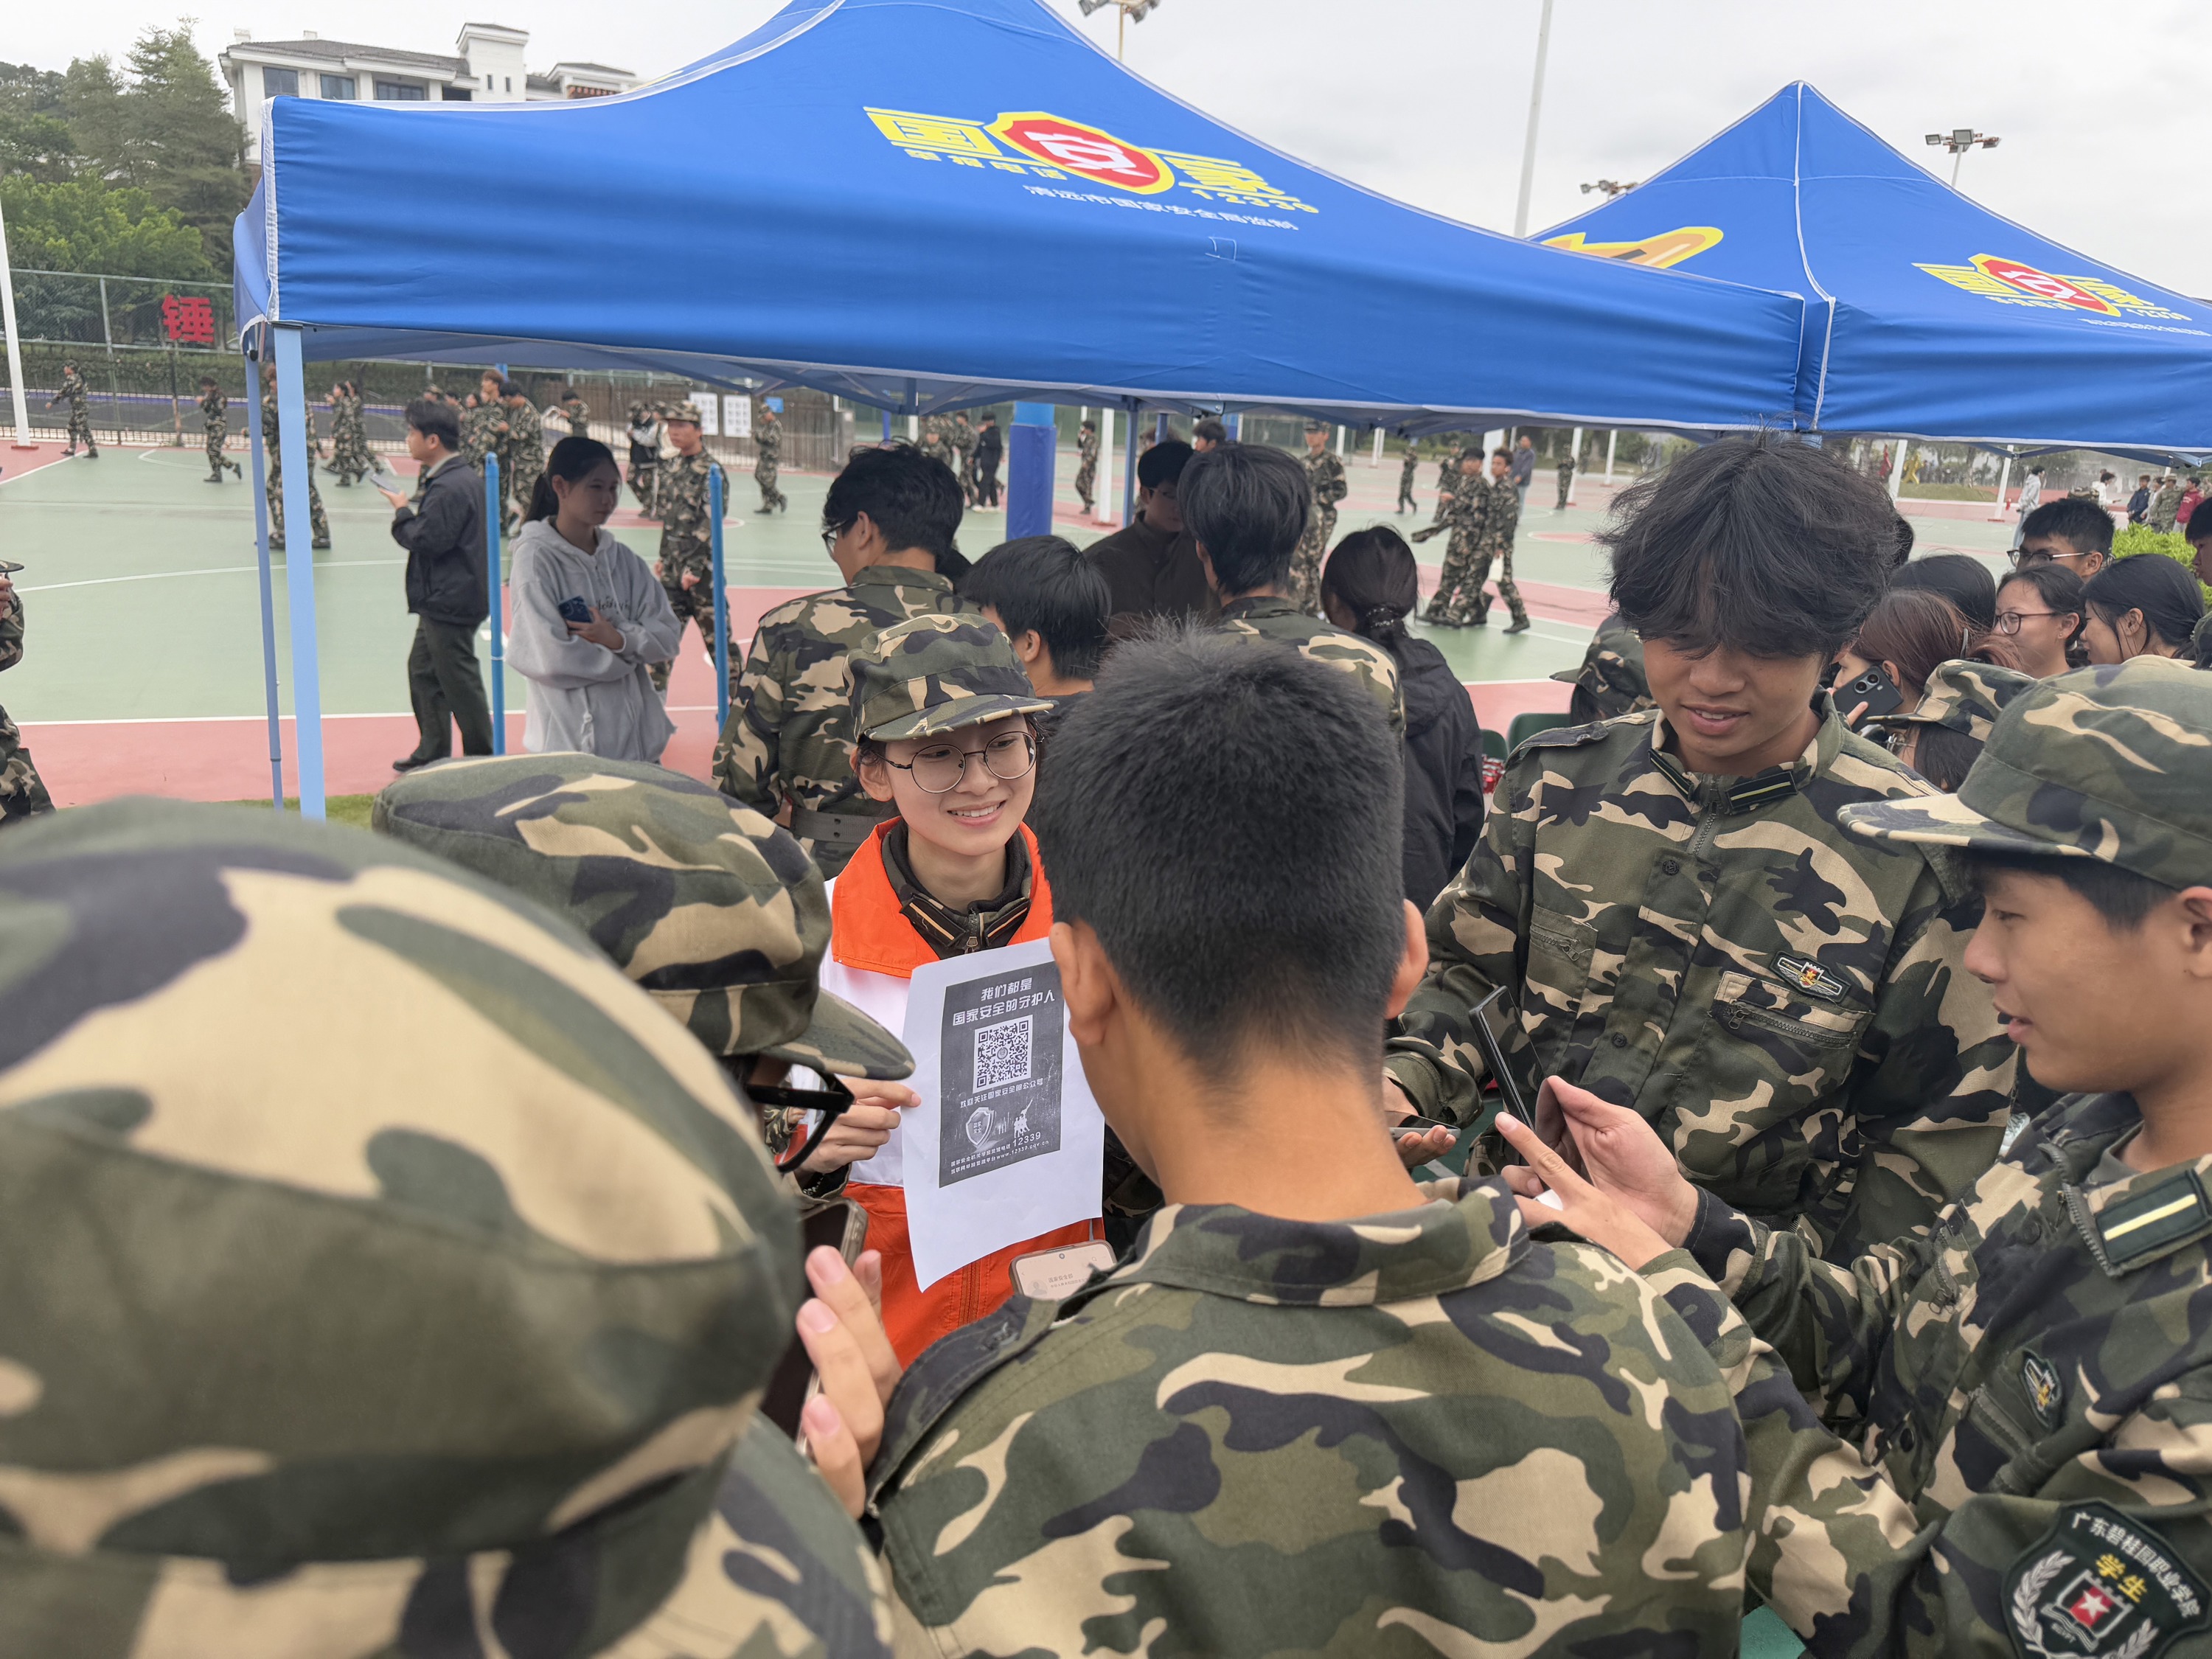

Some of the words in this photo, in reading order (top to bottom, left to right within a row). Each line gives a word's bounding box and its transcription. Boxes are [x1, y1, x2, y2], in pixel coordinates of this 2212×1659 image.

[1192, 189, 1319, 214] 12339
[162, 294, 215, 343] 锤
[953, 989, 1055, 1026] 国家安全的守护人
[981, 977, 1032, 1001] 我们都是
[1012, 1132, 1041, 1147] 12339
[2071, 1512, 2201, 1618] 广东碧桂园职业学院
[2096, 1553, 2148, 1604] 学生
